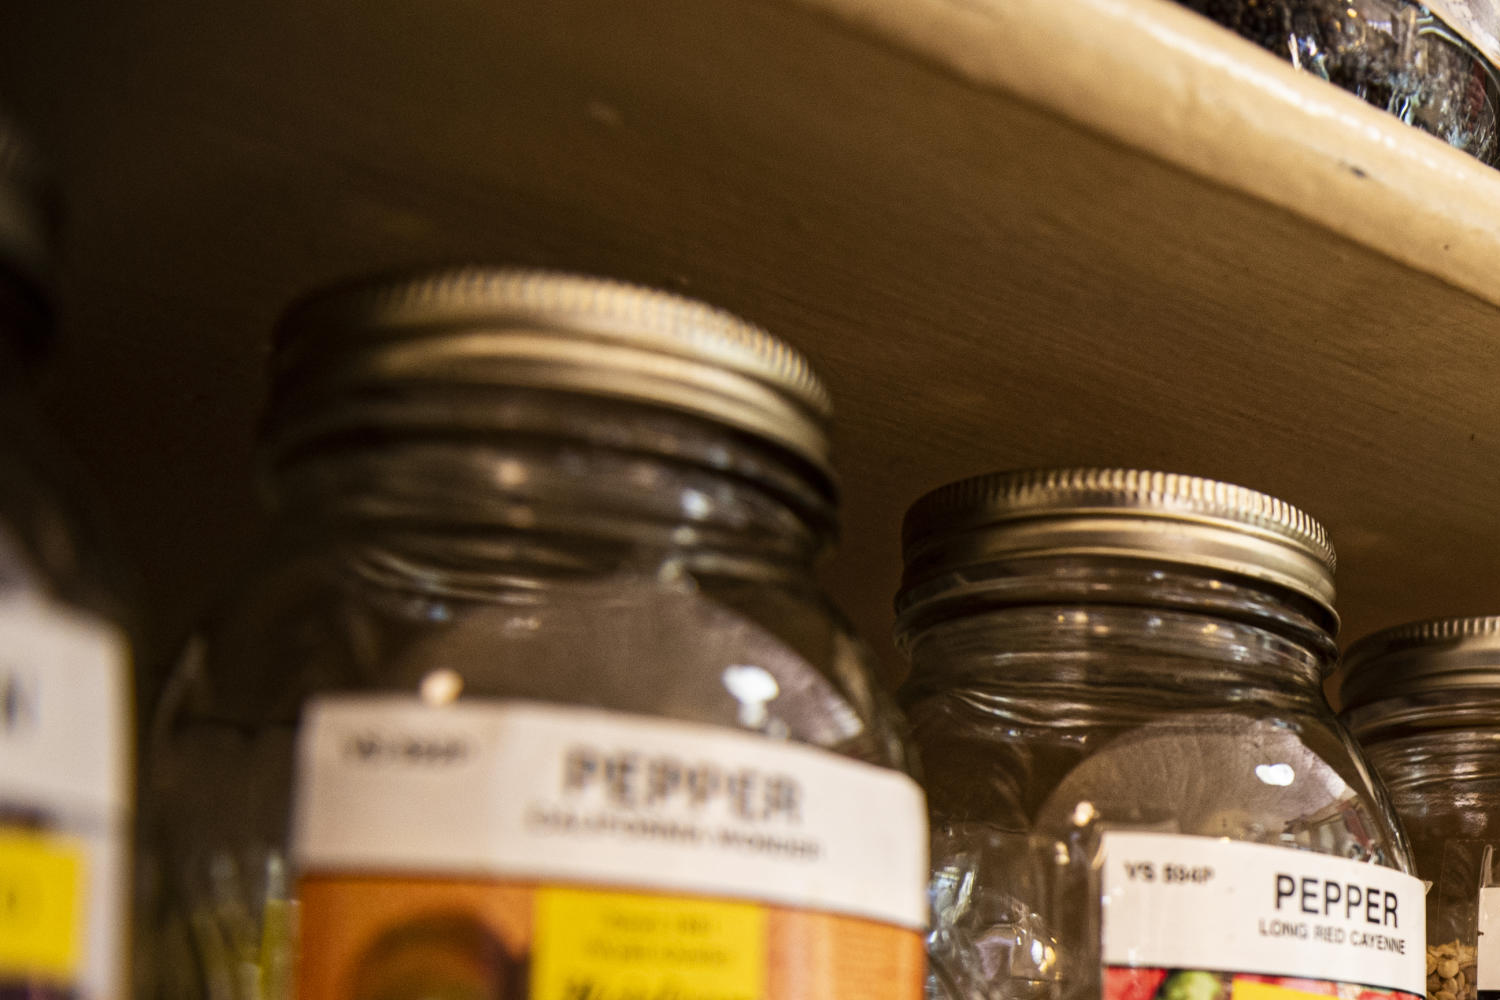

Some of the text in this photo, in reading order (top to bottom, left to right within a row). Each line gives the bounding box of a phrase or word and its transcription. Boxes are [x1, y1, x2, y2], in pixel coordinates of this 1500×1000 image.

[563, 743, 803, 826] PEPPER
[1124, 862, 1156, 882] VS
[1275, 873, 1400, 930] PEPPER
[1258, 918, 1406, 955] LONG RED CAYENNE
